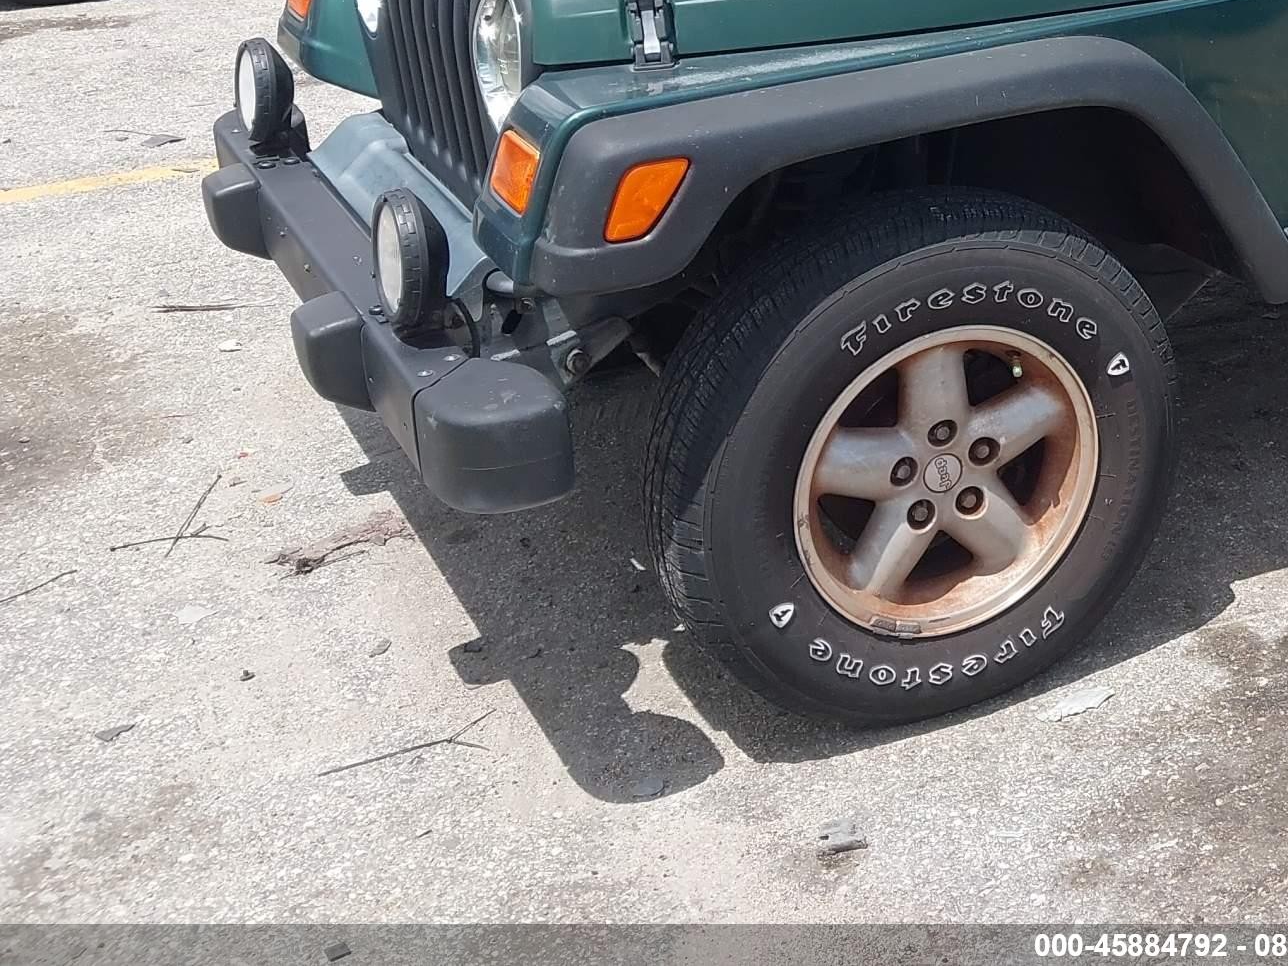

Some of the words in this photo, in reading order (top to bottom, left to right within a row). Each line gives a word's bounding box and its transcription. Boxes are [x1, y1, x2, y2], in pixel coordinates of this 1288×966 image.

[840, 280, 1099, 357] Firestone
[934, 457, 953, 490] Jeep
[808, 605, 1066, 691] Firestone
